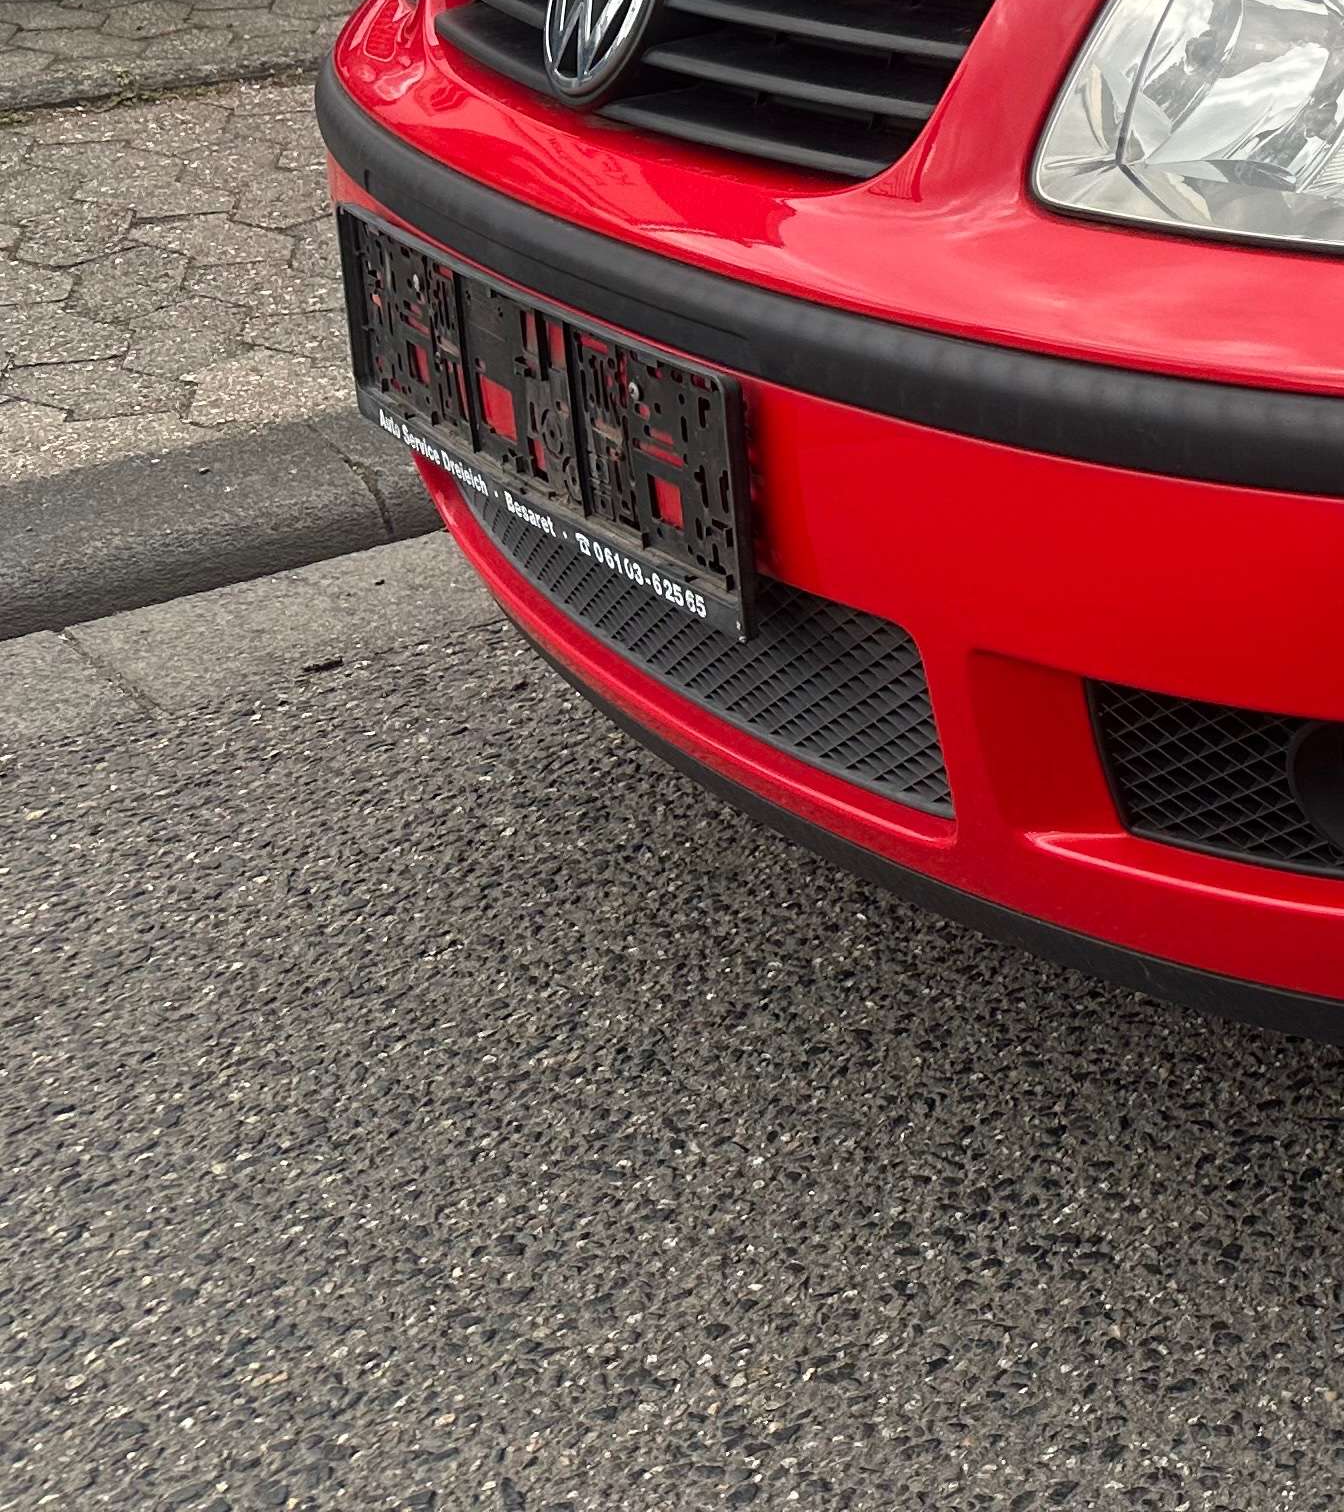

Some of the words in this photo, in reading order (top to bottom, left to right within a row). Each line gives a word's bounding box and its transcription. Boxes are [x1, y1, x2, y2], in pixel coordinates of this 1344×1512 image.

[379, 408, 401, 439] Auto
[401, 424, 441, 465] Service
[440, 449, 489, 497] Dreieich
[504, 490, 557, 537] Besaret
